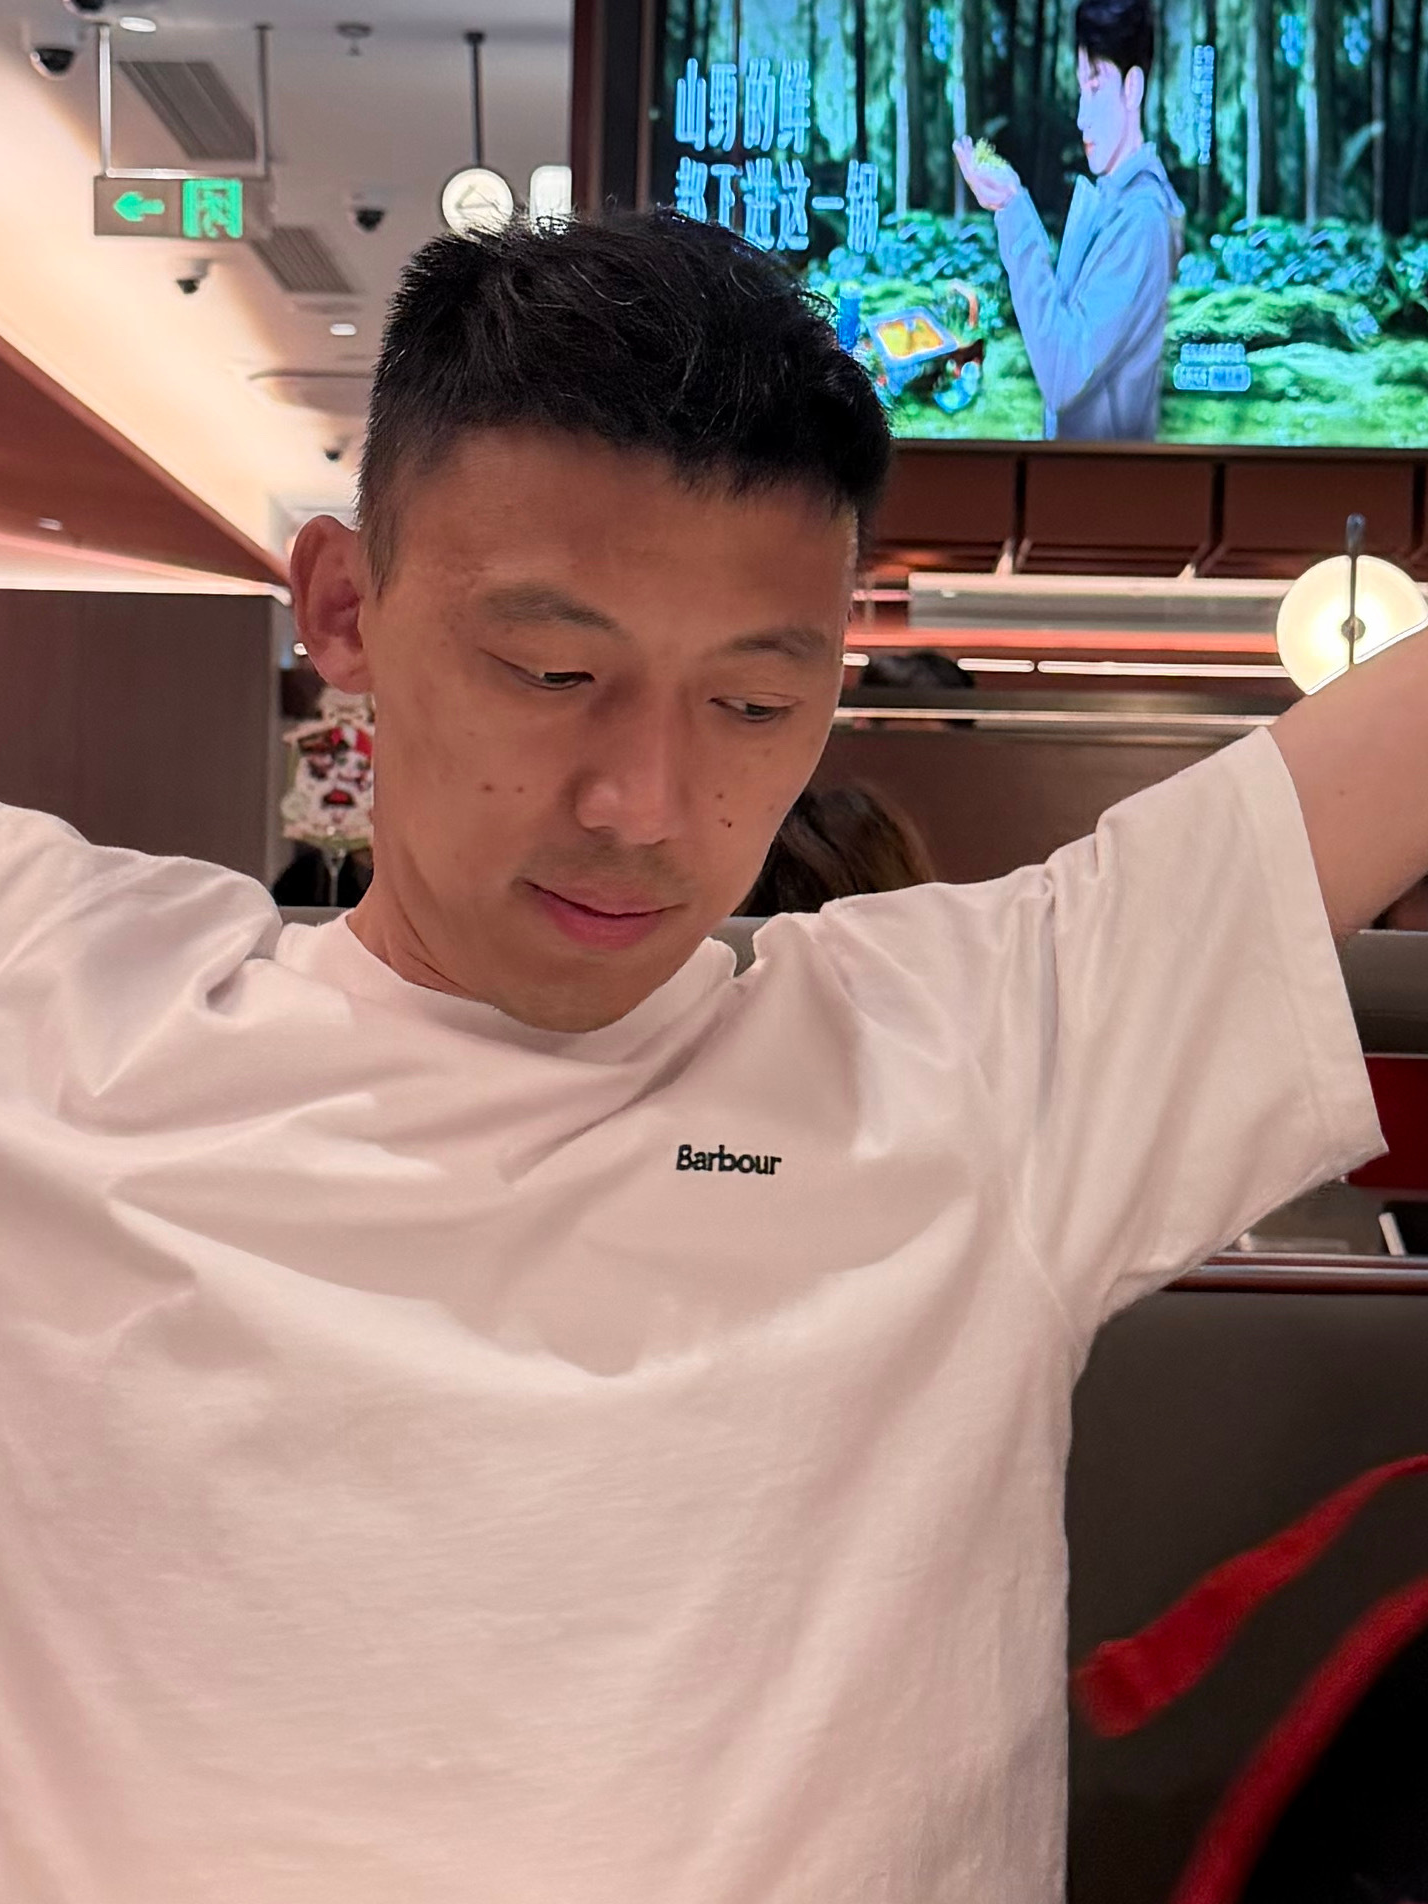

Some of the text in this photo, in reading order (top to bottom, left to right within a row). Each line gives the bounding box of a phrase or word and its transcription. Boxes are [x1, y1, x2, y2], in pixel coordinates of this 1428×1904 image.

[675, 57, 811, 154] 山野的鲜
[675, 1144, 782, 1176] Barbour
